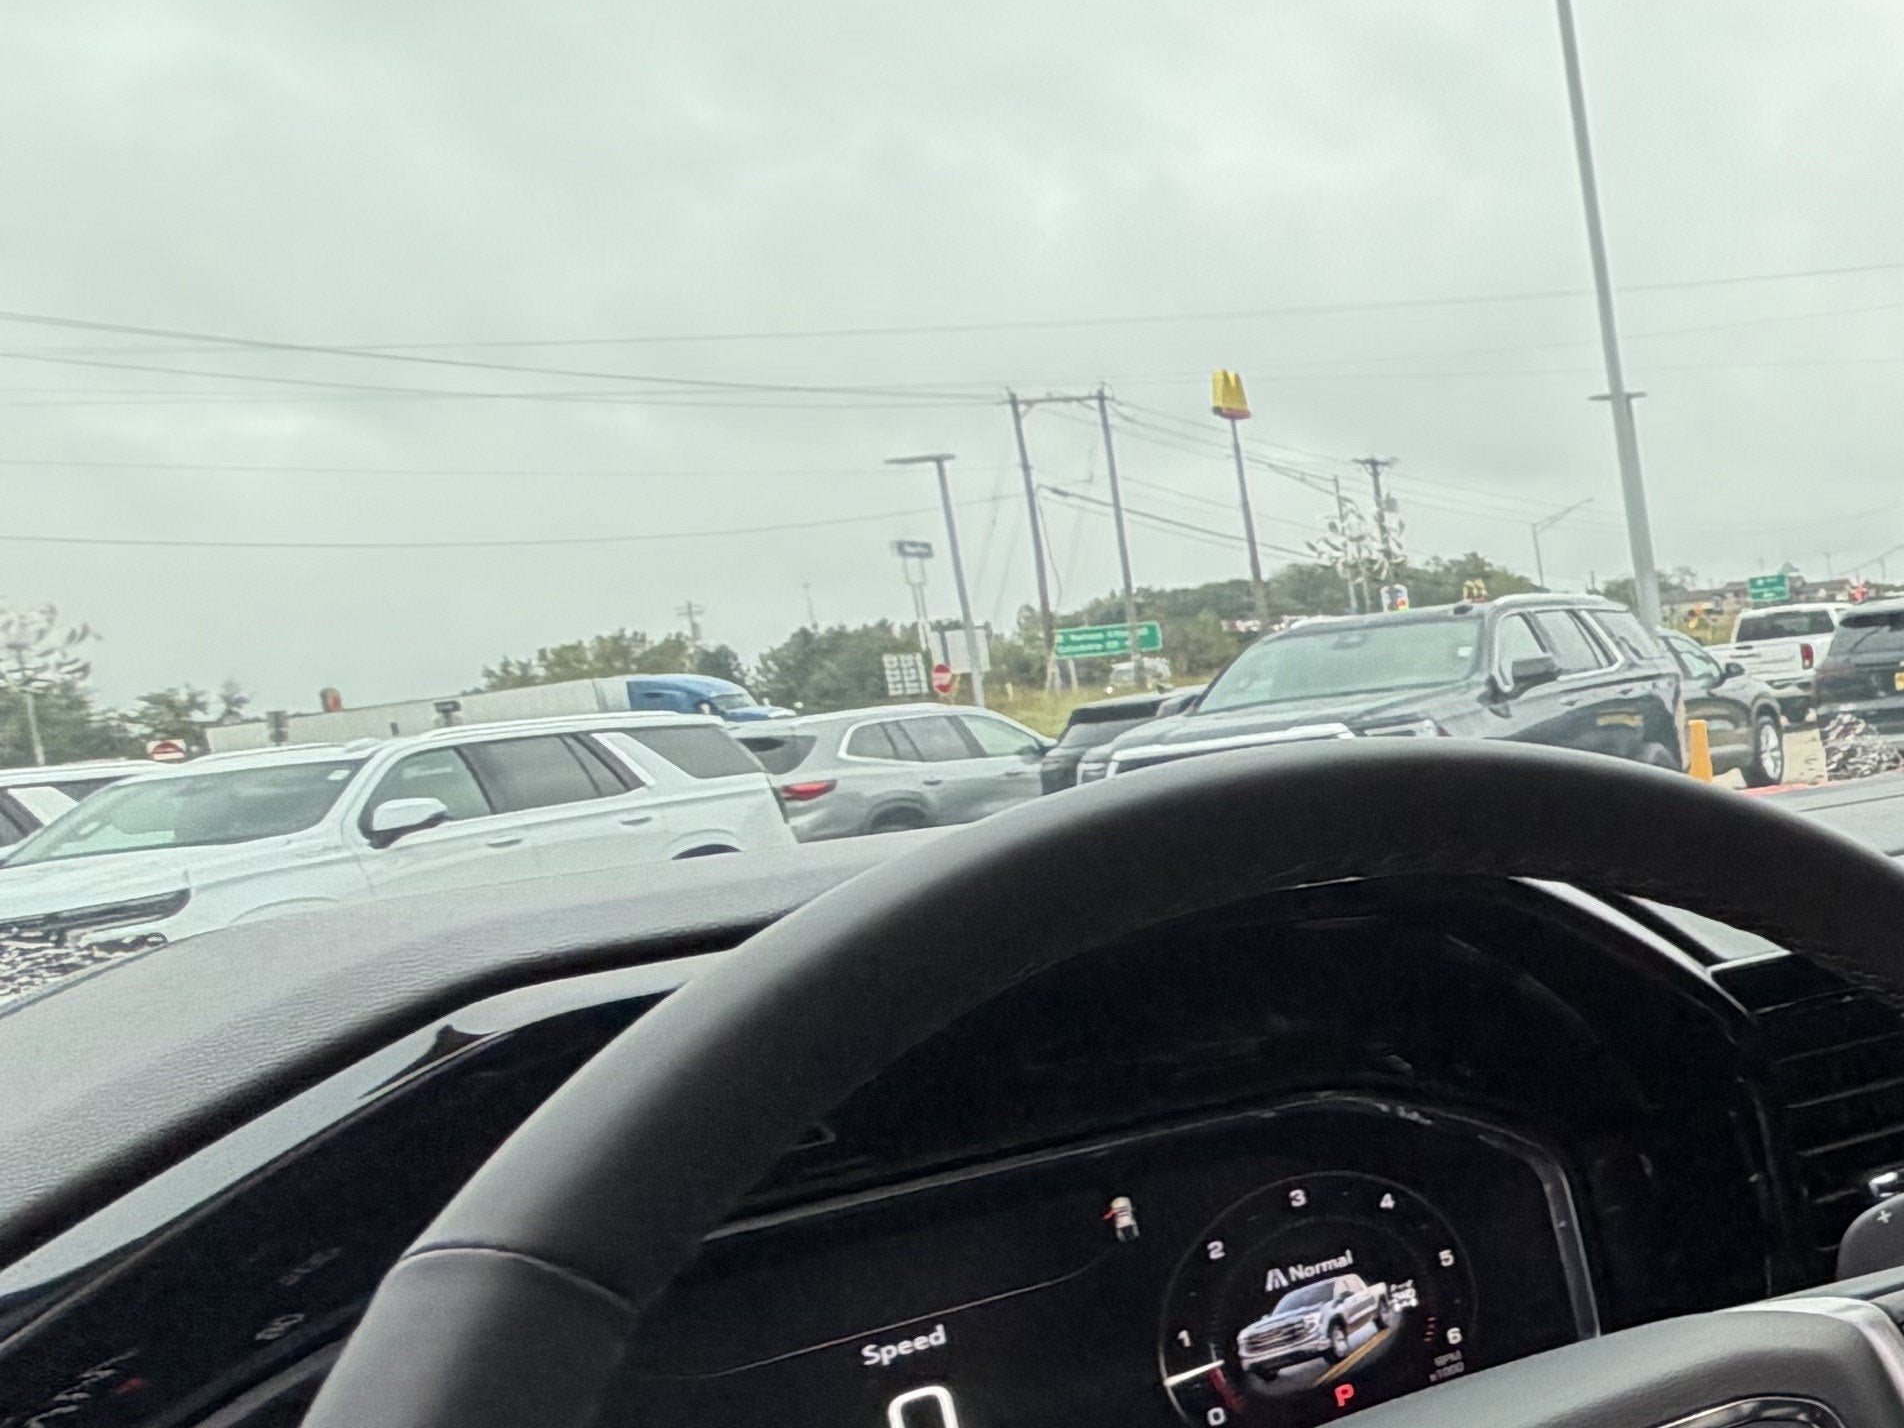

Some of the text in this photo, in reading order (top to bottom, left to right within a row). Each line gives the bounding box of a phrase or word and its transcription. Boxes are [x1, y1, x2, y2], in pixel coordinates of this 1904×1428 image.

[1290, 1189, 1307, 1206] 3
[1380, 1193, 1395, 1209] 4
[1207, 1241, 1225, 1259] 2
[1439, 1249, 1454, 1267] 5
[1288, 1249, 1353, 1282] Normal
[861, 1324, 947, 1366] Speed
[1178, 1330, 1191, 1347] 1
[1447, 1327, 1462, 1345] 6
[1335, 1383, 1354, 1406] P
[1207, 1407, 1225, 1425] 0
